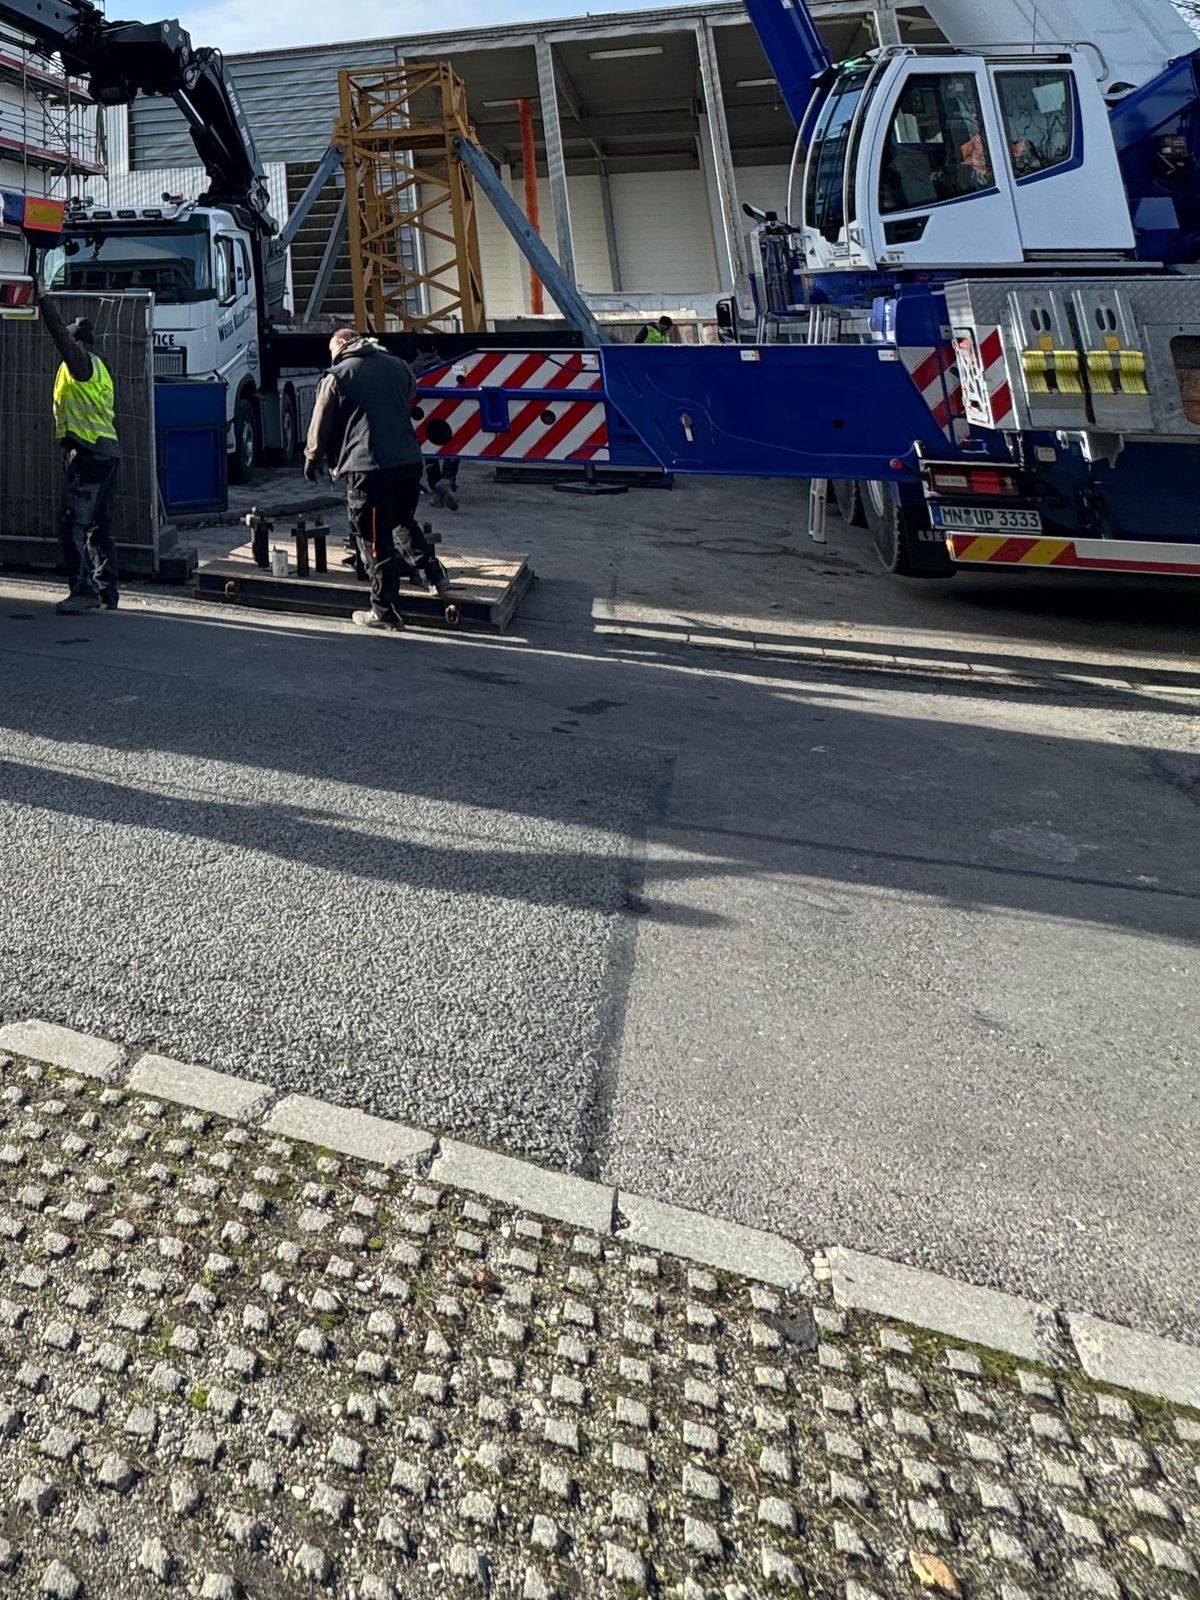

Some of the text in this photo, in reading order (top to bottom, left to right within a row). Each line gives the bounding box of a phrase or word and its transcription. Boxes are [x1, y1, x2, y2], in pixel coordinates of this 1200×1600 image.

[942, 506, 1039, 528] MN UP 3333
